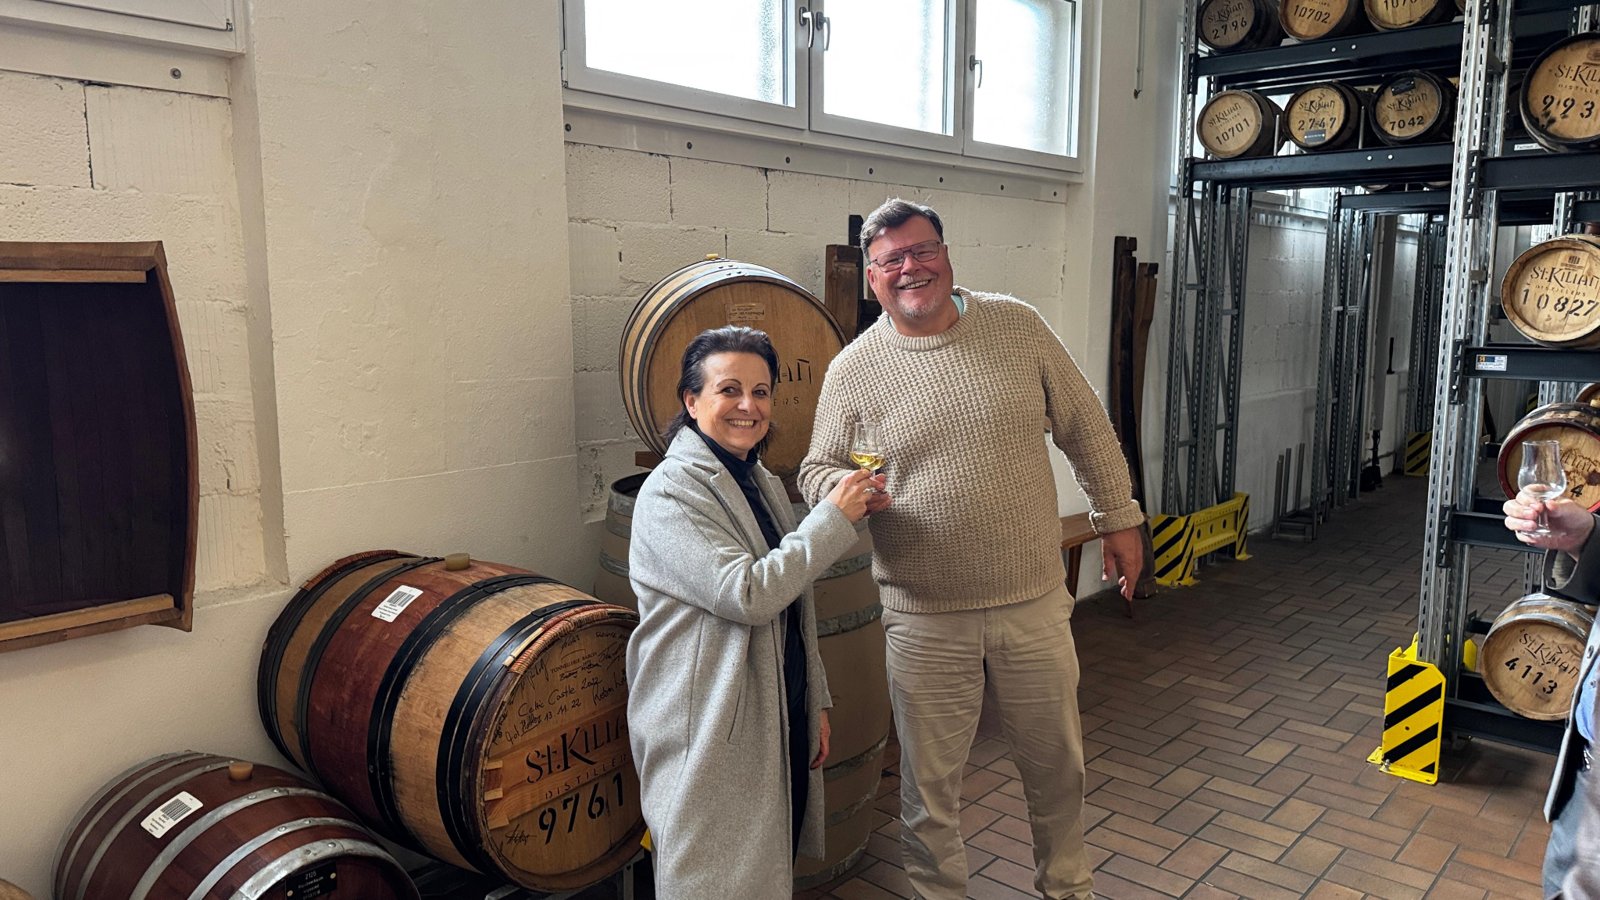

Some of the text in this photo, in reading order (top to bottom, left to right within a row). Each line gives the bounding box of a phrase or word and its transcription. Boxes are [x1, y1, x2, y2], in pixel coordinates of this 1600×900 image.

[1293, 5, 1331, 23] 10702
[1212, 17, 1247, 39] 2796
[1215, 118, 1249, 145] 10701
[1390, 116, 1424, 131] 7042
[1523, 289, 1599, 317] 10827
[1505, 657, 1558, 695] 4113
[545, 754, 627, 800] DISTILLER
[538, 771, 624, 845] 9761
